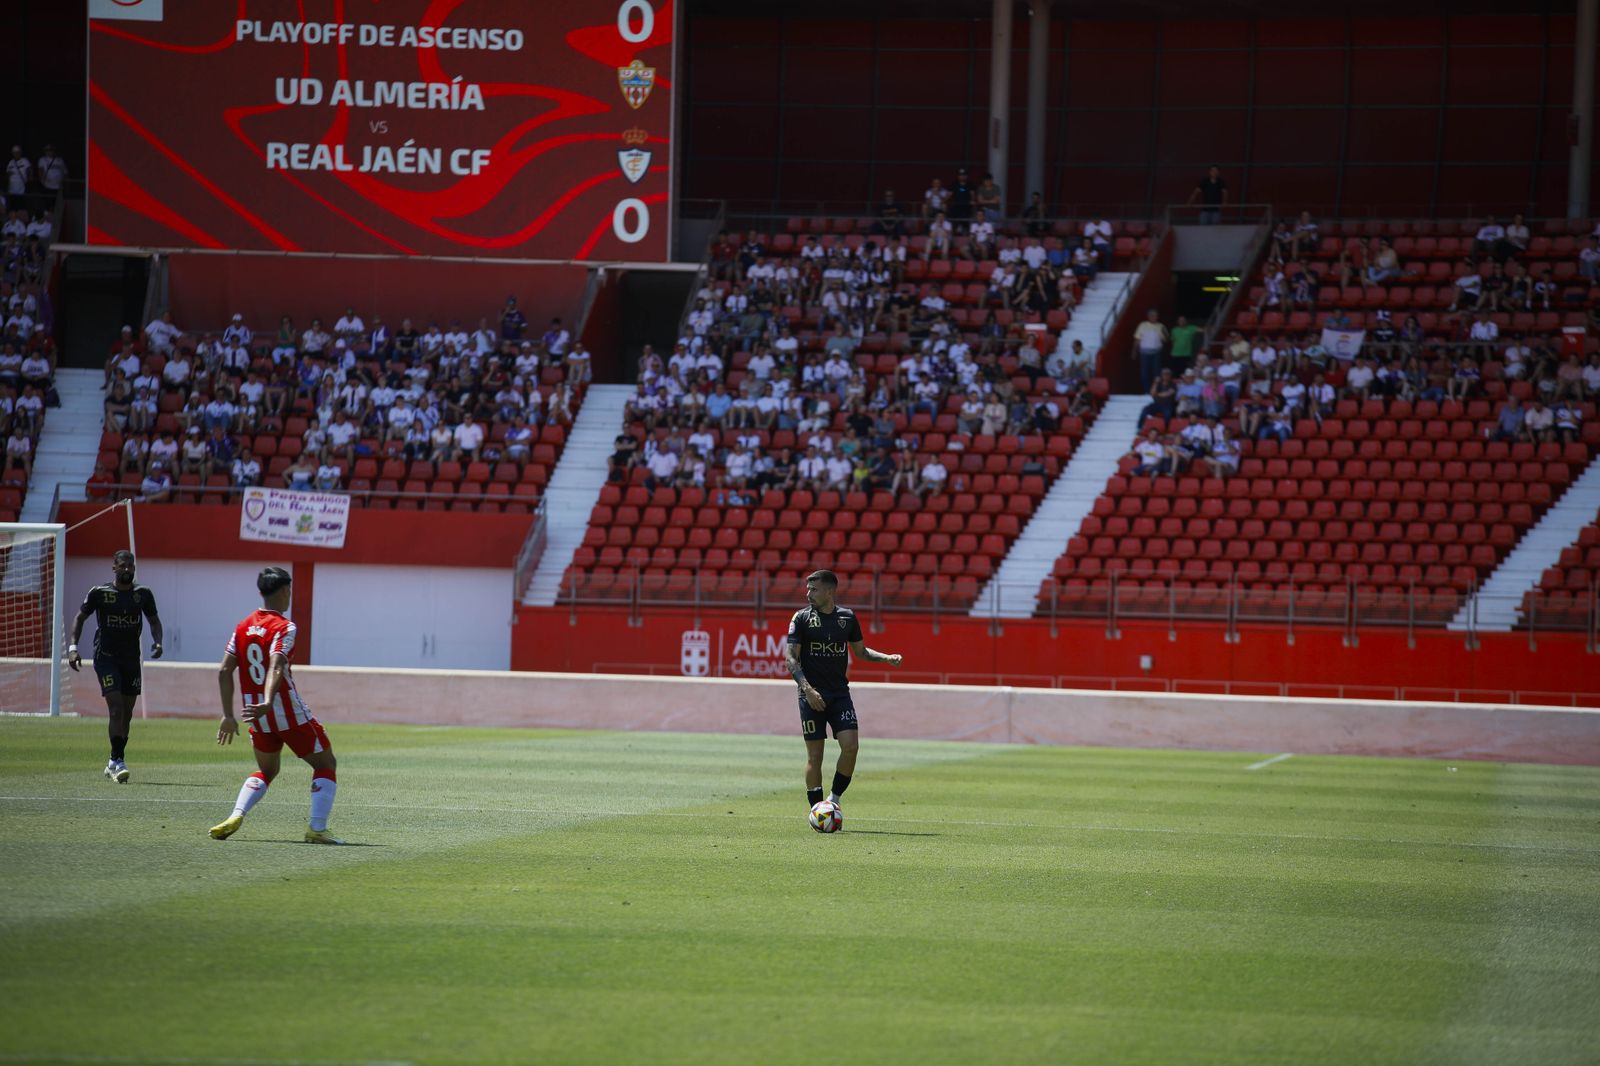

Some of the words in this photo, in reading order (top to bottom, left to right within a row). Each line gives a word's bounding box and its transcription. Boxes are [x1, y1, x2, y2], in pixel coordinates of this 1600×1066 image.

[617, 0, 654, 42] 0
[236, 20, 354, 45] PLAYOFF
[359, 24, 395, 46] DE
[399, 26, 524, 51] ASCENSO
[275, 77, 323, 105] UD
[329, 75, 485, 110] ALMERÍA
[369, 120, 388, 134] VS
[266, 142, 353, 172] REAL
[358, 138, 441, 174] JAÉN
[450, 148, 492, 175] CF
[612, 198, 650, 243] 0
[104, 592, 117, 603] 15
[732, 633, 788, 657] ALM
[810, 642, 846, 653] PKW
[246, 643, 266, 686] 8
[102, 675, 113, 687] 15
[803, 719, 816, 735] 10
